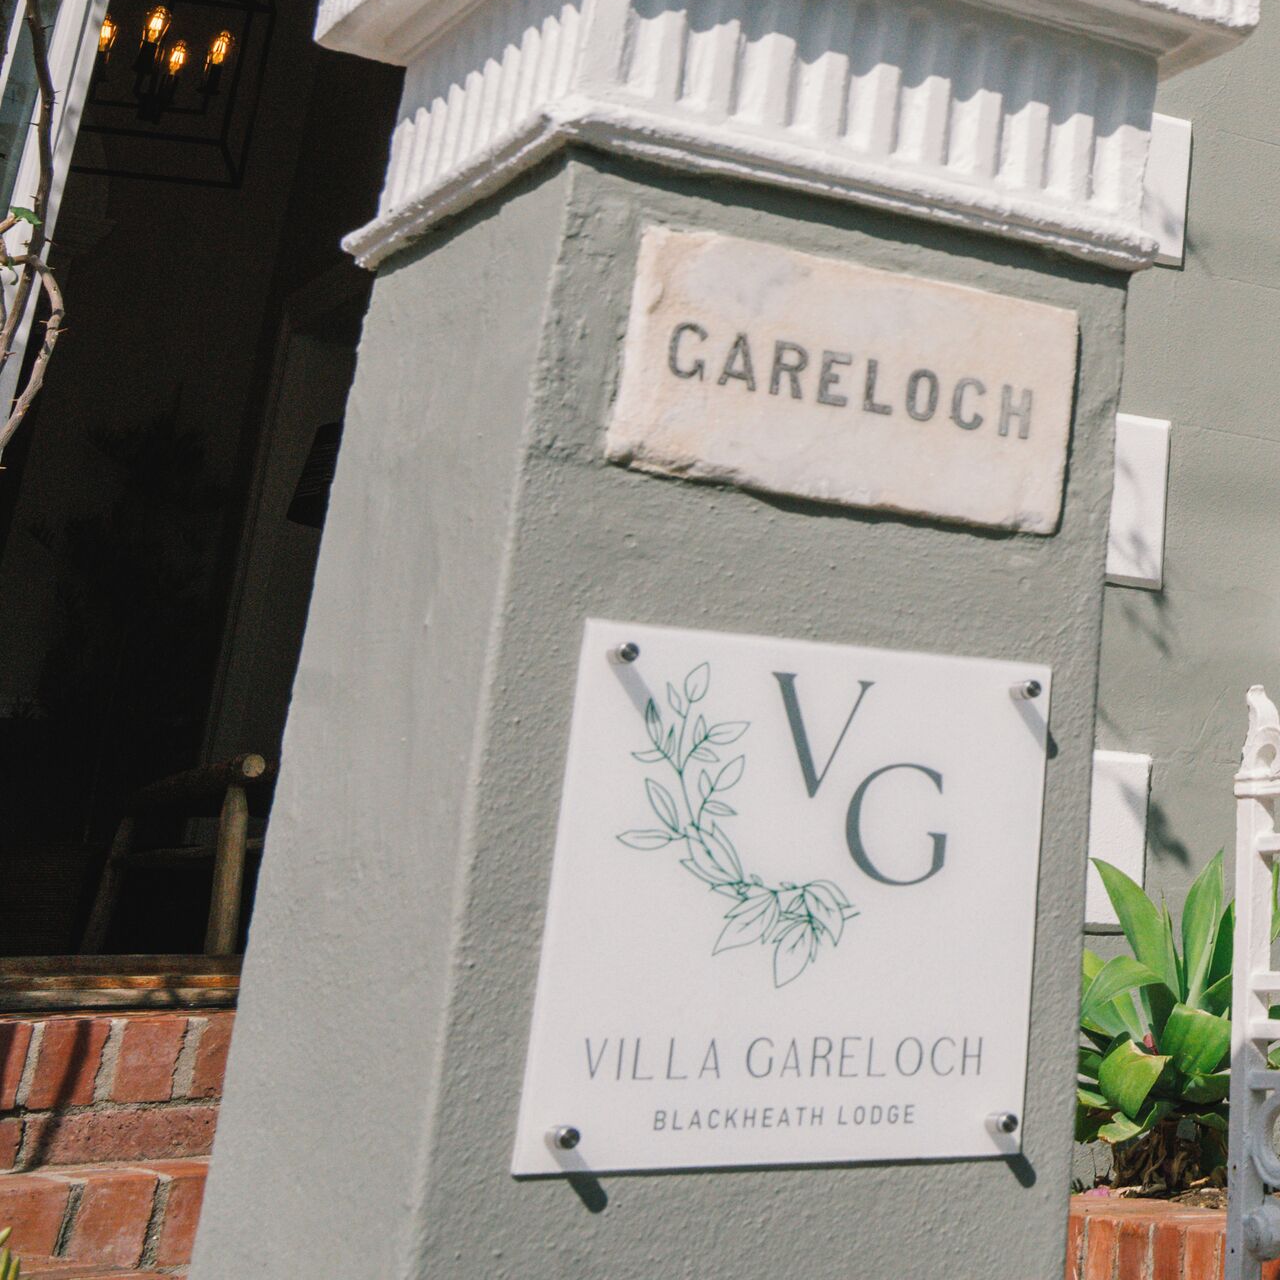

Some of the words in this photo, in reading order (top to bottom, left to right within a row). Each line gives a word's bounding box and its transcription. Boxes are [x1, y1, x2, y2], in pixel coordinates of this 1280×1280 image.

[667, 321, 1034, 440] GARELOCH
[584, 1037, 722, 1081] VILLA
[745, 1036, 984, 1079] GARELOCH
[652, 1105, 825, 1131] BLACKHEATH
[838, 1103, 916, 1126] LODGE
